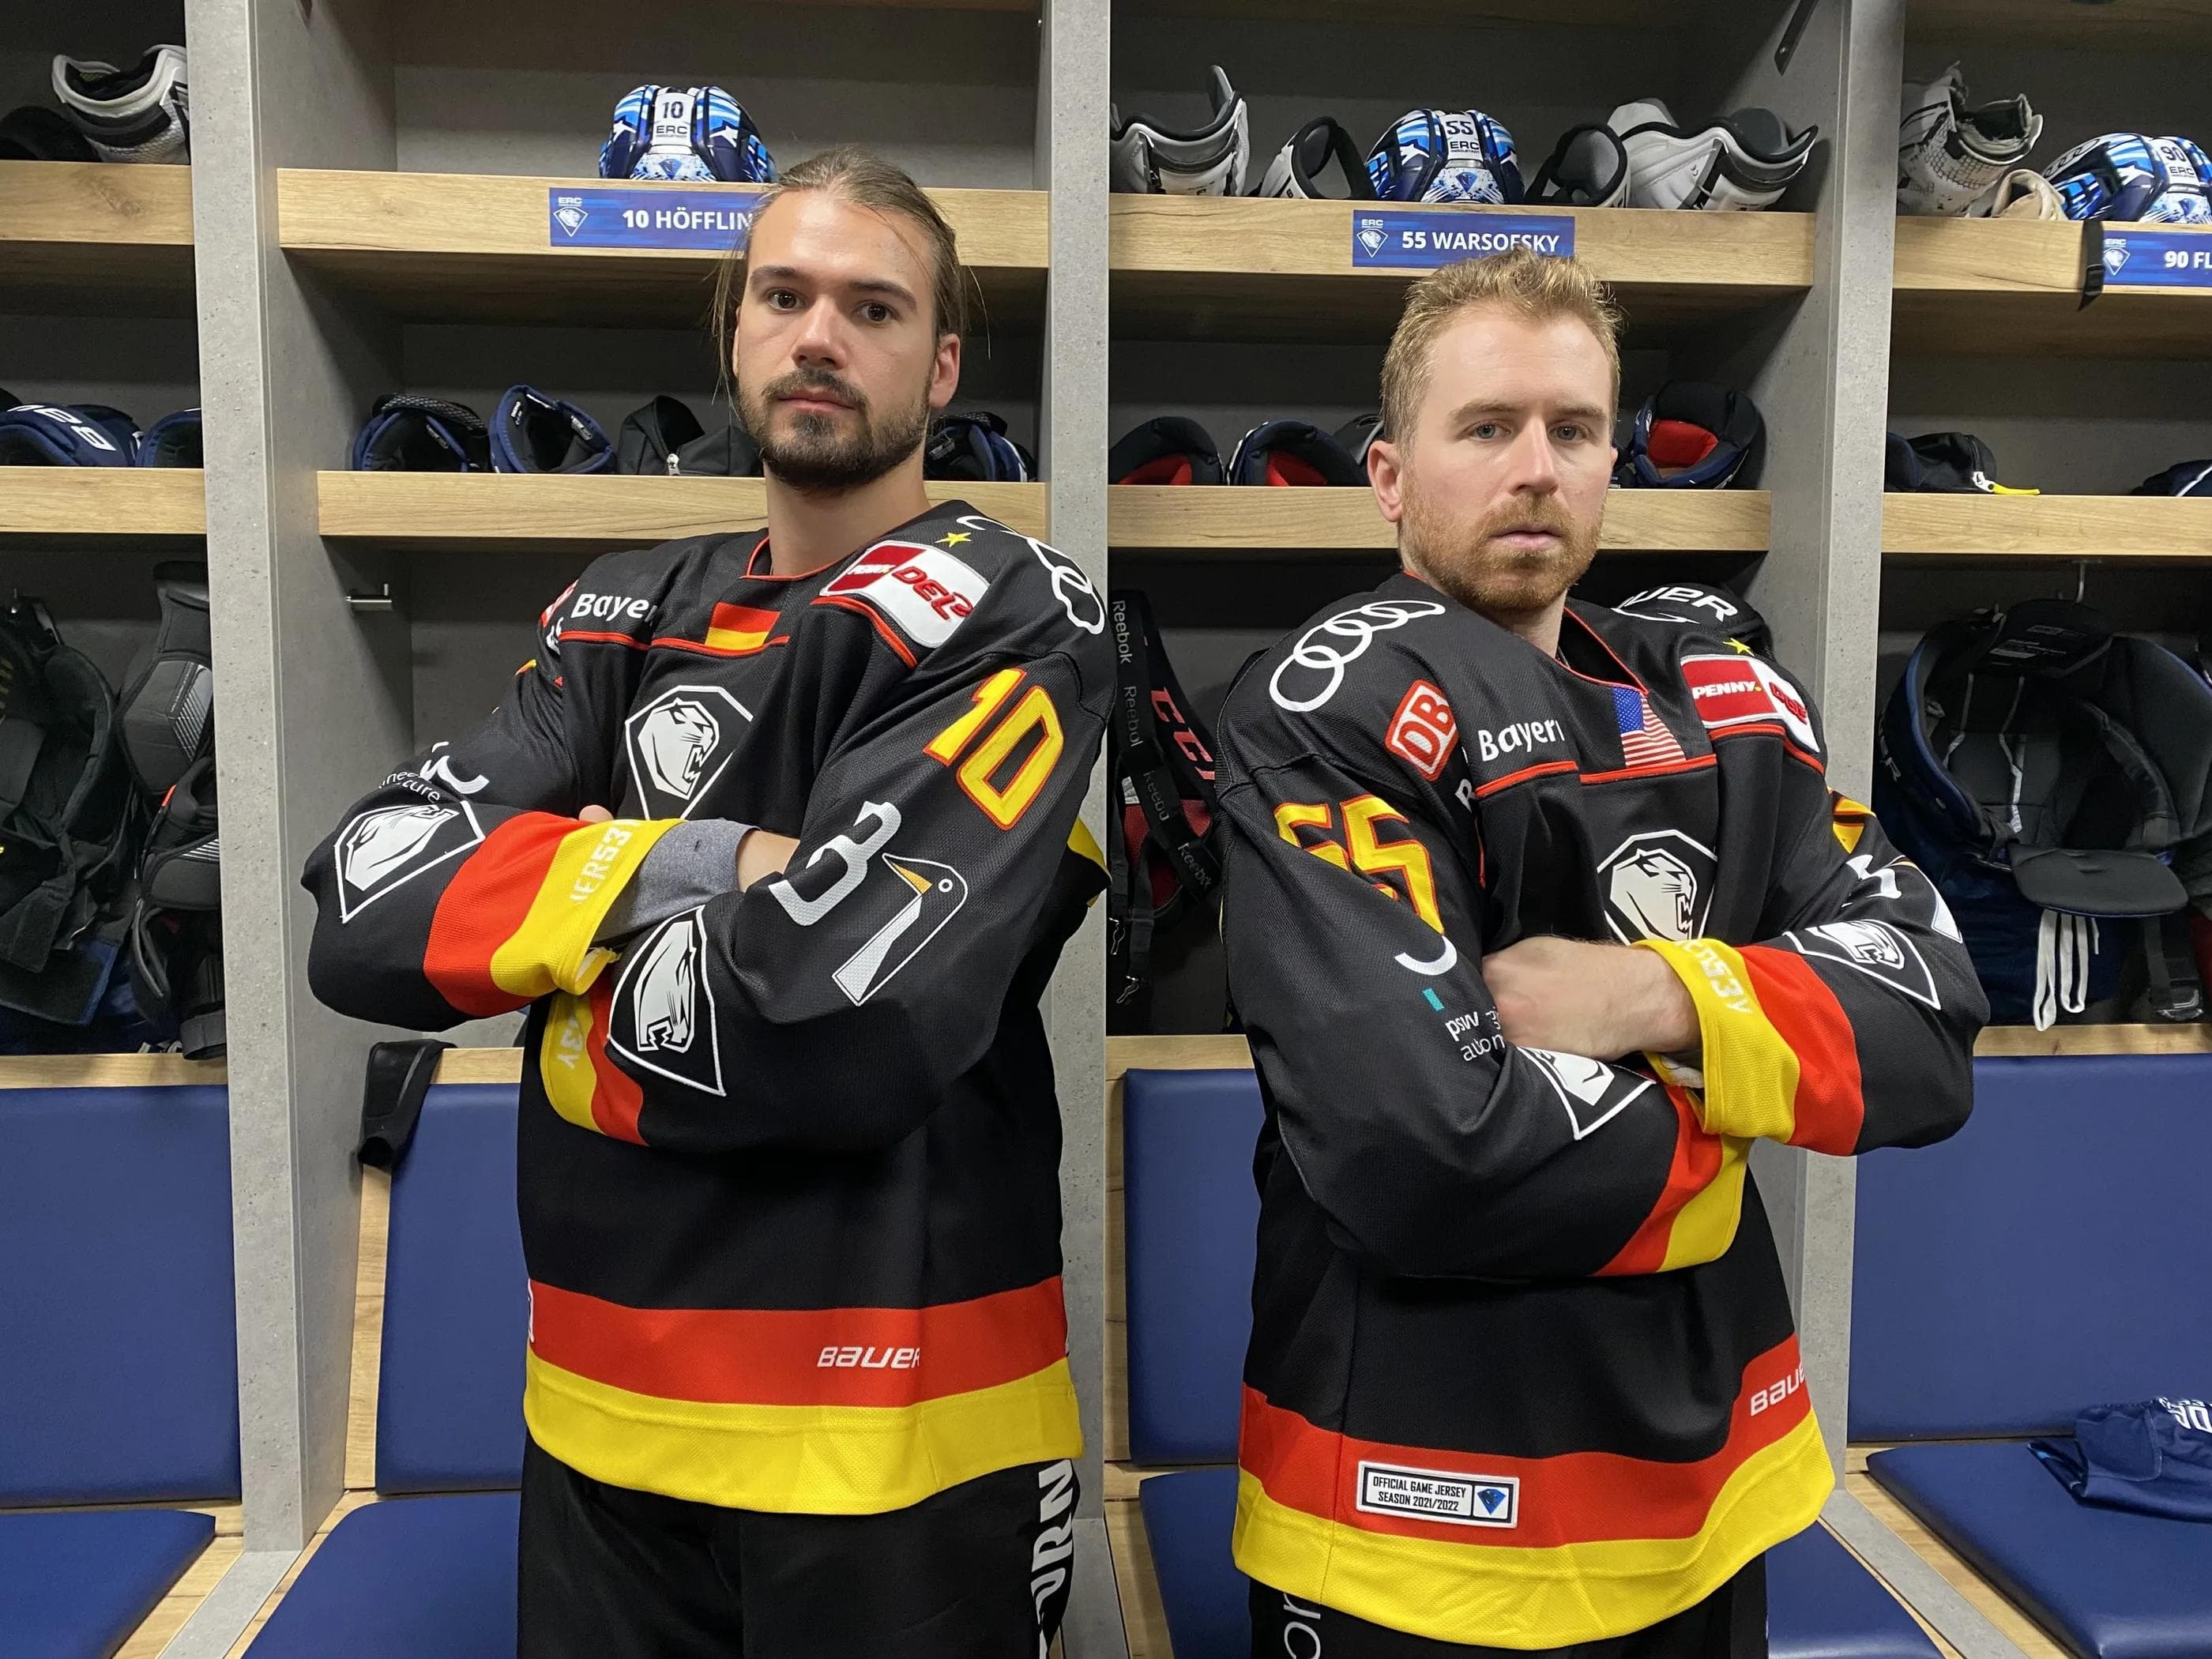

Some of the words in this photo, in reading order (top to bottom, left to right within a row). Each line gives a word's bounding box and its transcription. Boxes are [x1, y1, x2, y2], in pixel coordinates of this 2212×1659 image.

[660, 100, 684, 119] 10
[656, 125, 688, 134] ERC
[1446, 120, 1474, 135] 55
[1450, 140, 1480, 150] ERC
[2161, 145, 2187, 162] 90
[2169, 166, 2195, 176] ERC
[558, 196, 582, 205] ERC
[622, 209, 649, 229] 10
[1401, 231, 1427, 250] 55
[1431, 231, 1560, 253] WARSOFSKY
[2164, 250, 2189, 269] 90
[1112, 600, 1133, 664] Reebok
[1397, 694, 1456, 771] DB
[1477, 719, 1565, 762] Bayer
[923, 666, 1064, 831] 10
[1373, 1476, 1408, 1492] OFFICIAL
[1410, 1480, 1433, 1495] GAME
[1435, 1484, 1467, 1499] JERSEY
[1378, 1491, 1411, 1506] SEASON
[1413, 1495, 1460, 1512] 2021/2022
